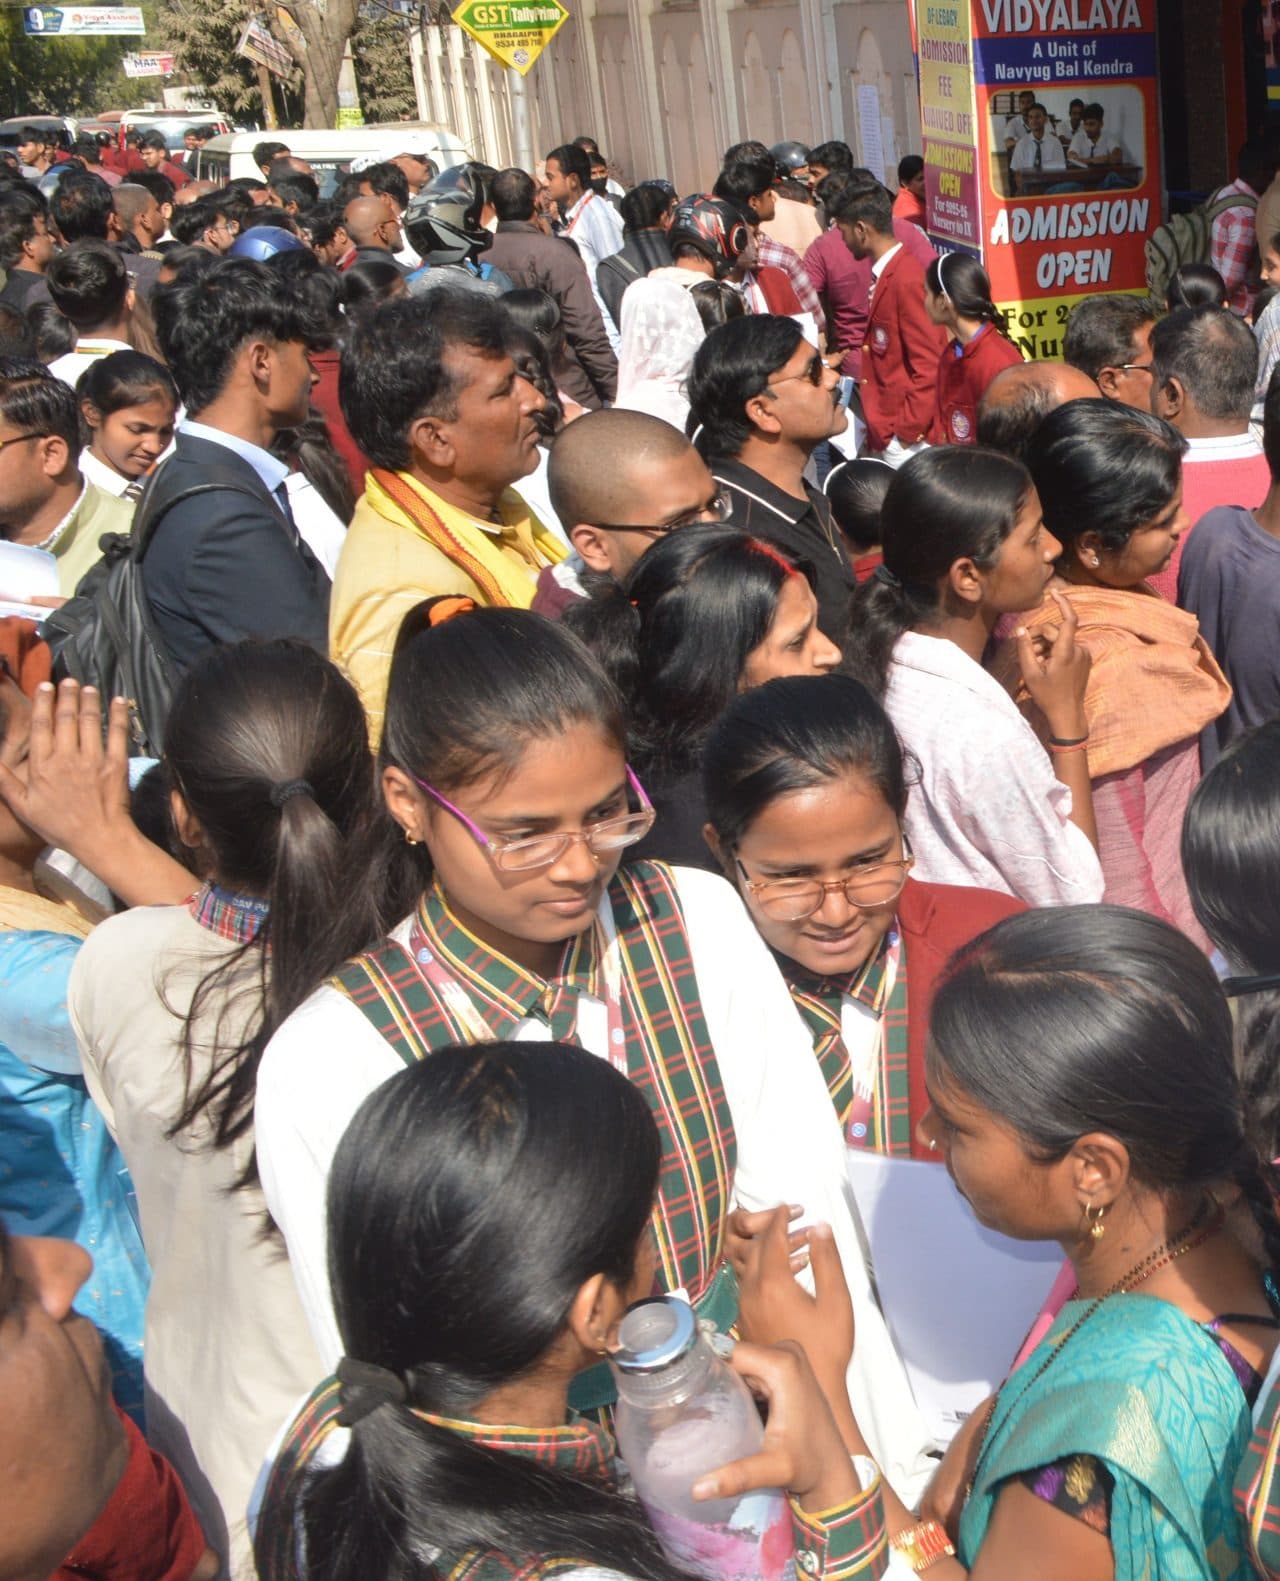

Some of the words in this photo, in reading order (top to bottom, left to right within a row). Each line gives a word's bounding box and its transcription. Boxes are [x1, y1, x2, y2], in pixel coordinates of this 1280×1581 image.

[29, 8, 45, 31] 9
[473, 5, 509, 24] GST
[980, 0, 1142, 33] VIDYALAYA
[922, 39, 968, 65] ADMISSION
[1032, 42, 1043, 59] A
[1047, 41, 1079, 58] Unit
[1082, 40, 1097, 57] of
[134, 58, 158, 68] MAA
[995, 63, 1051, 82] Navyug
[1055, 60, 1079, 77] Bal
[1083, 59, 1134, 76] Kendra
[938, 75, 953, 98] FEE
[923, 105, 954, 132] WAIVED
[939, 171, 961, 198] OPEN
[990, 198, 1149, 245] ADMISSION
[1036, 248, 1112, 289] OPEN
[1002, 308, 1048, 330] For
